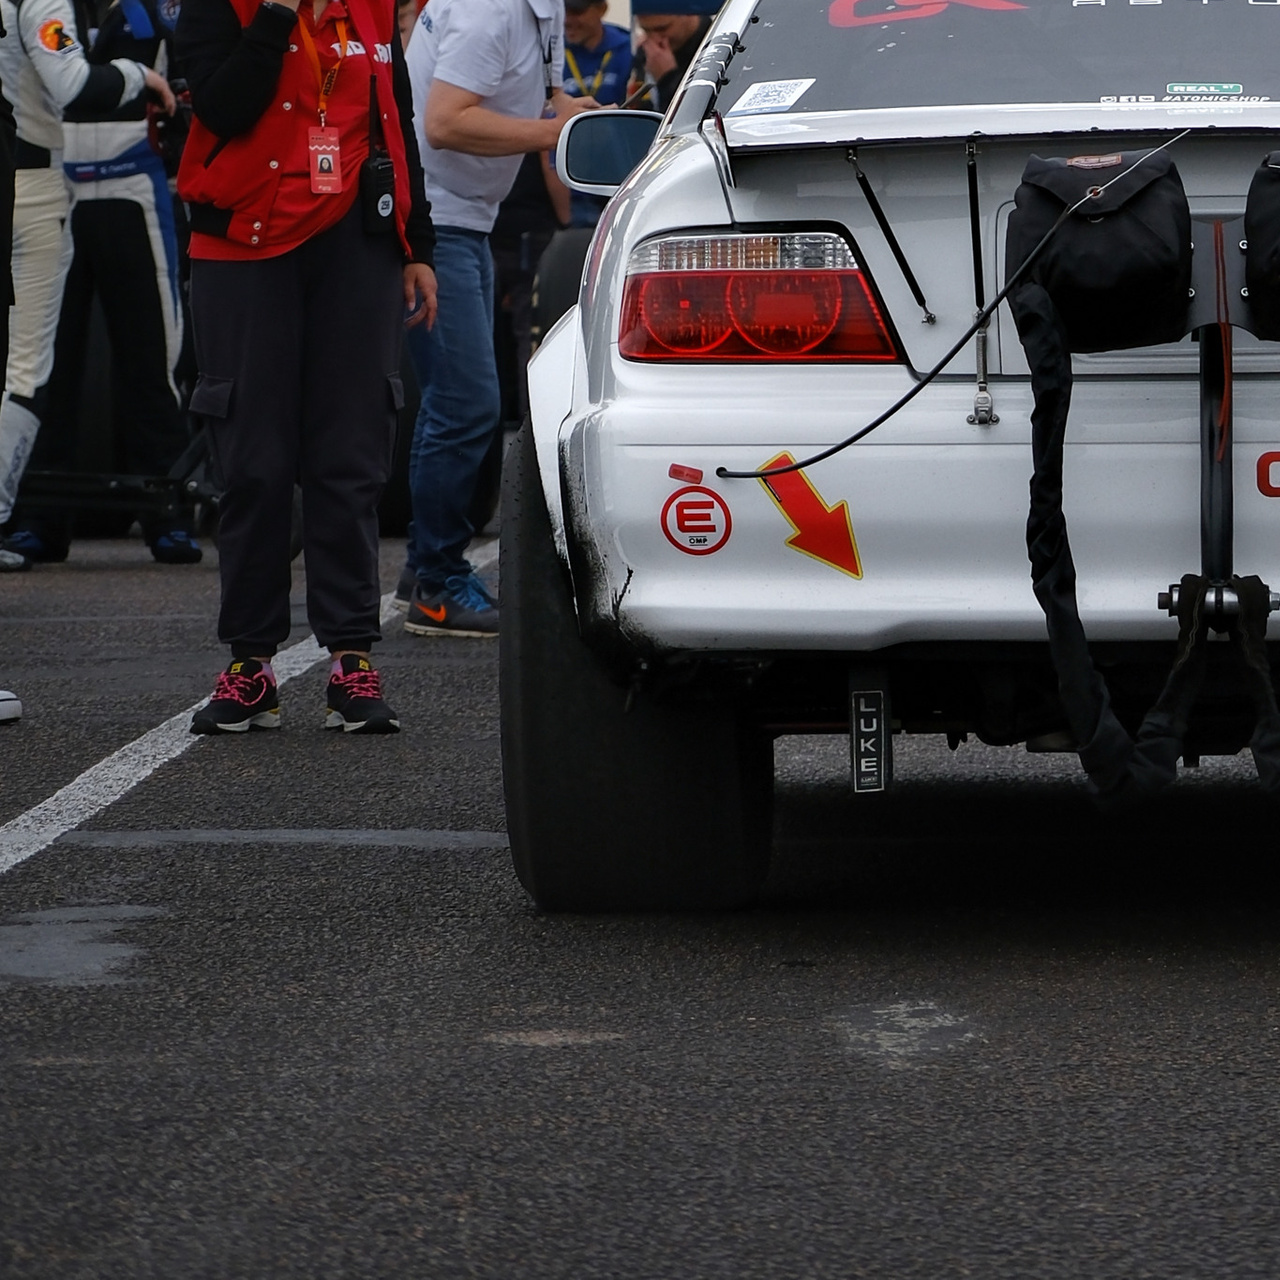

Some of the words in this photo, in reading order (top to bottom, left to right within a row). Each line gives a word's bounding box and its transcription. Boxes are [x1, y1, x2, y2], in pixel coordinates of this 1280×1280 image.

[1172, 85, 1221, 93] REAL
[688, 537, 708, 545] OMP
[859, 697, 878, 773] LUKE
